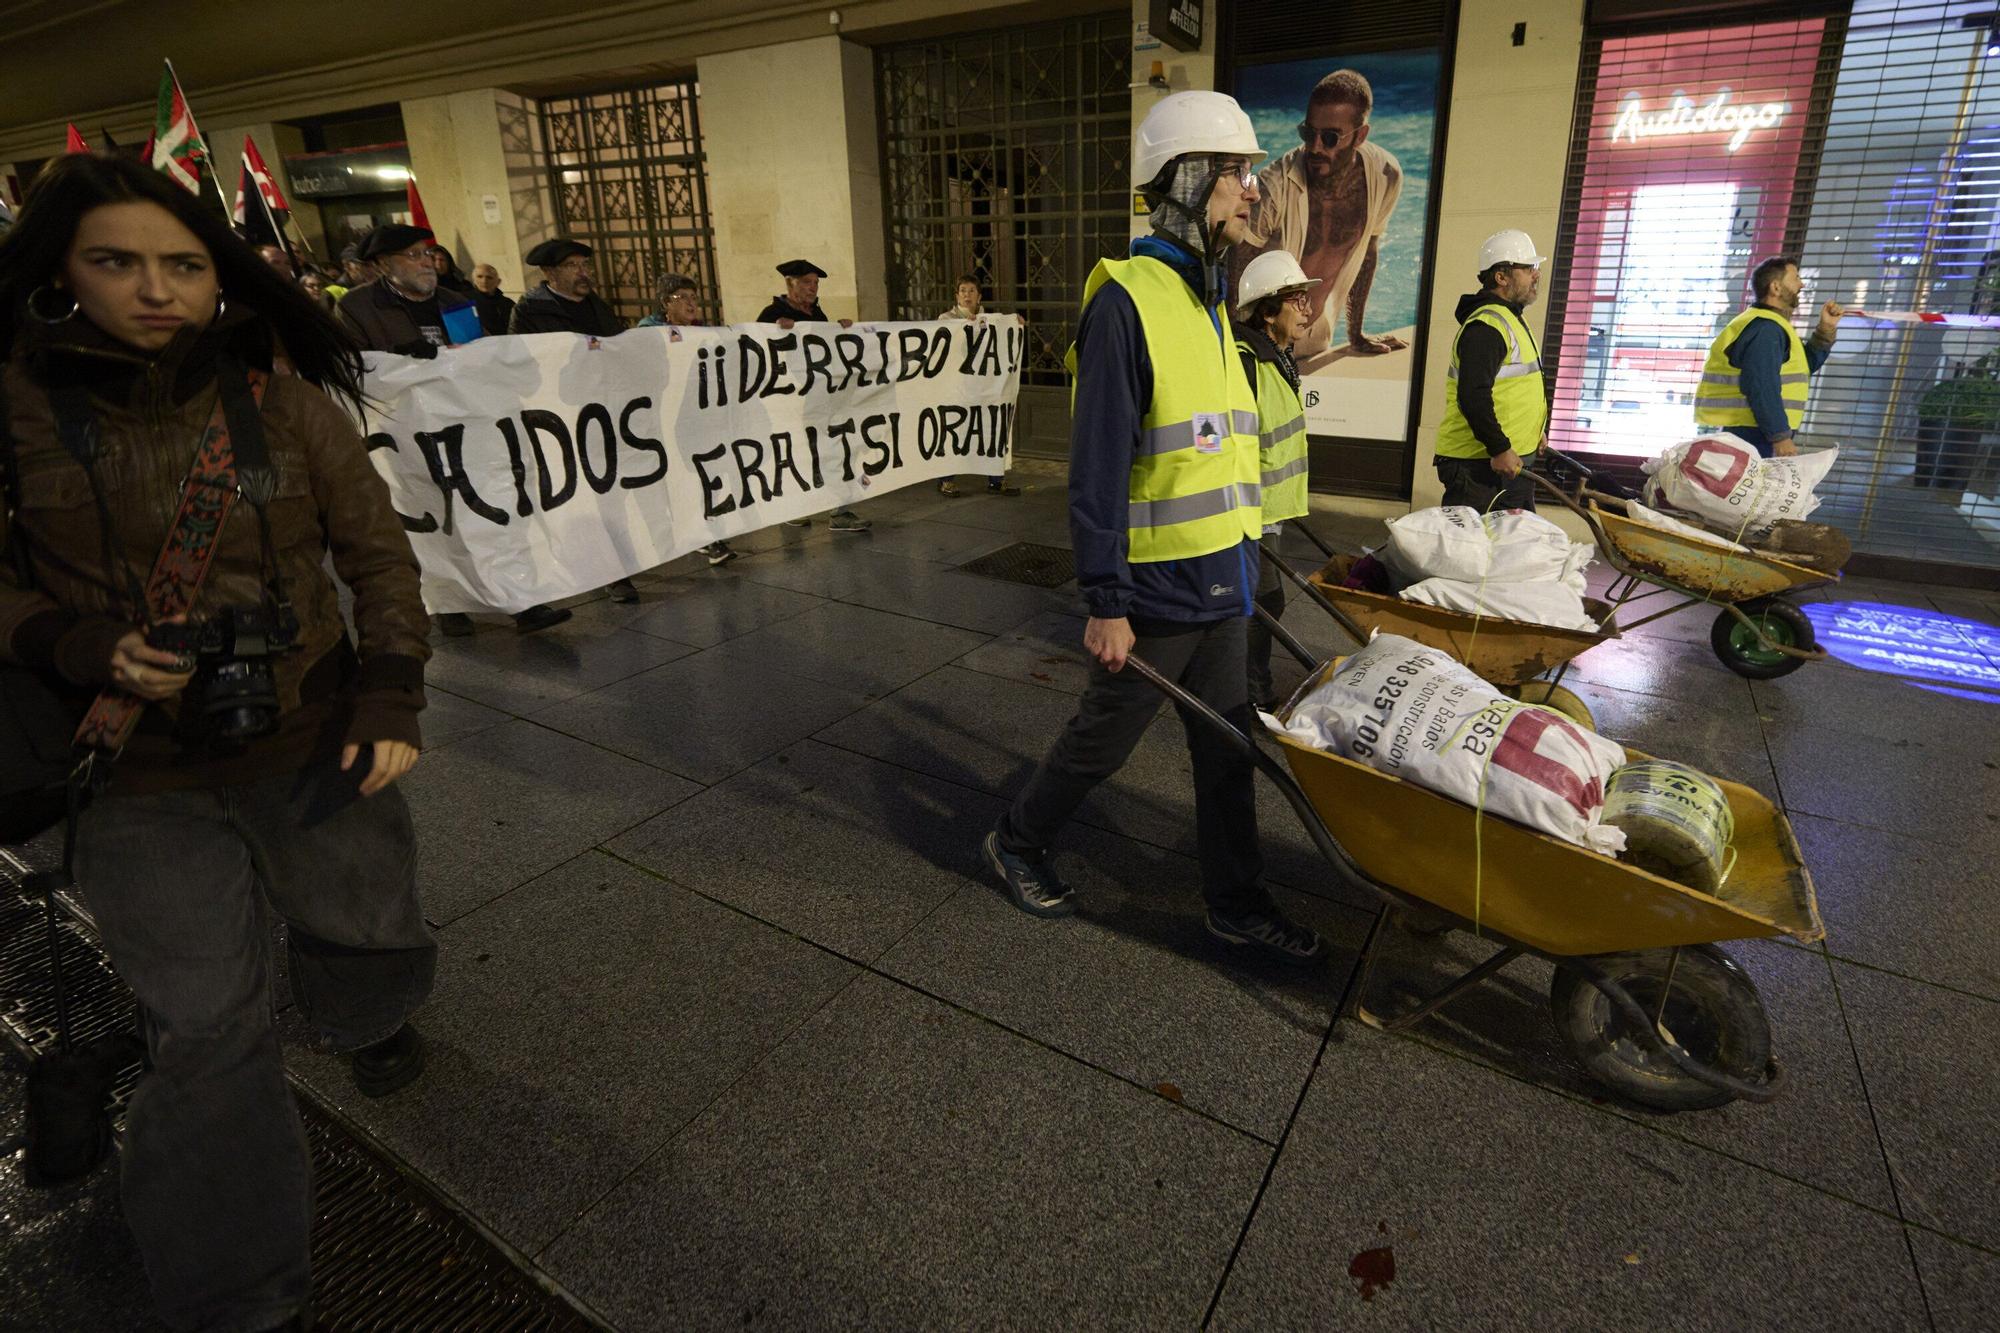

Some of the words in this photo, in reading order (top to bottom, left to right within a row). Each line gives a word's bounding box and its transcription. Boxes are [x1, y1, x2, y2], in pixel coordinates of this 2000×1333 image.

[959, 323, 1002, 377] YA
[692, 412, 903, 520] ERAITSI
[1778, 491, 1799, 514] 948
[1396, 655, 1435, 676] 948
[1374, 675, 1409, 712] 325
[1352, 713, 1387, 759] 106
[1387, 681, 1440, 770] construcción
[1422, 706, 1456, 751] Baños
